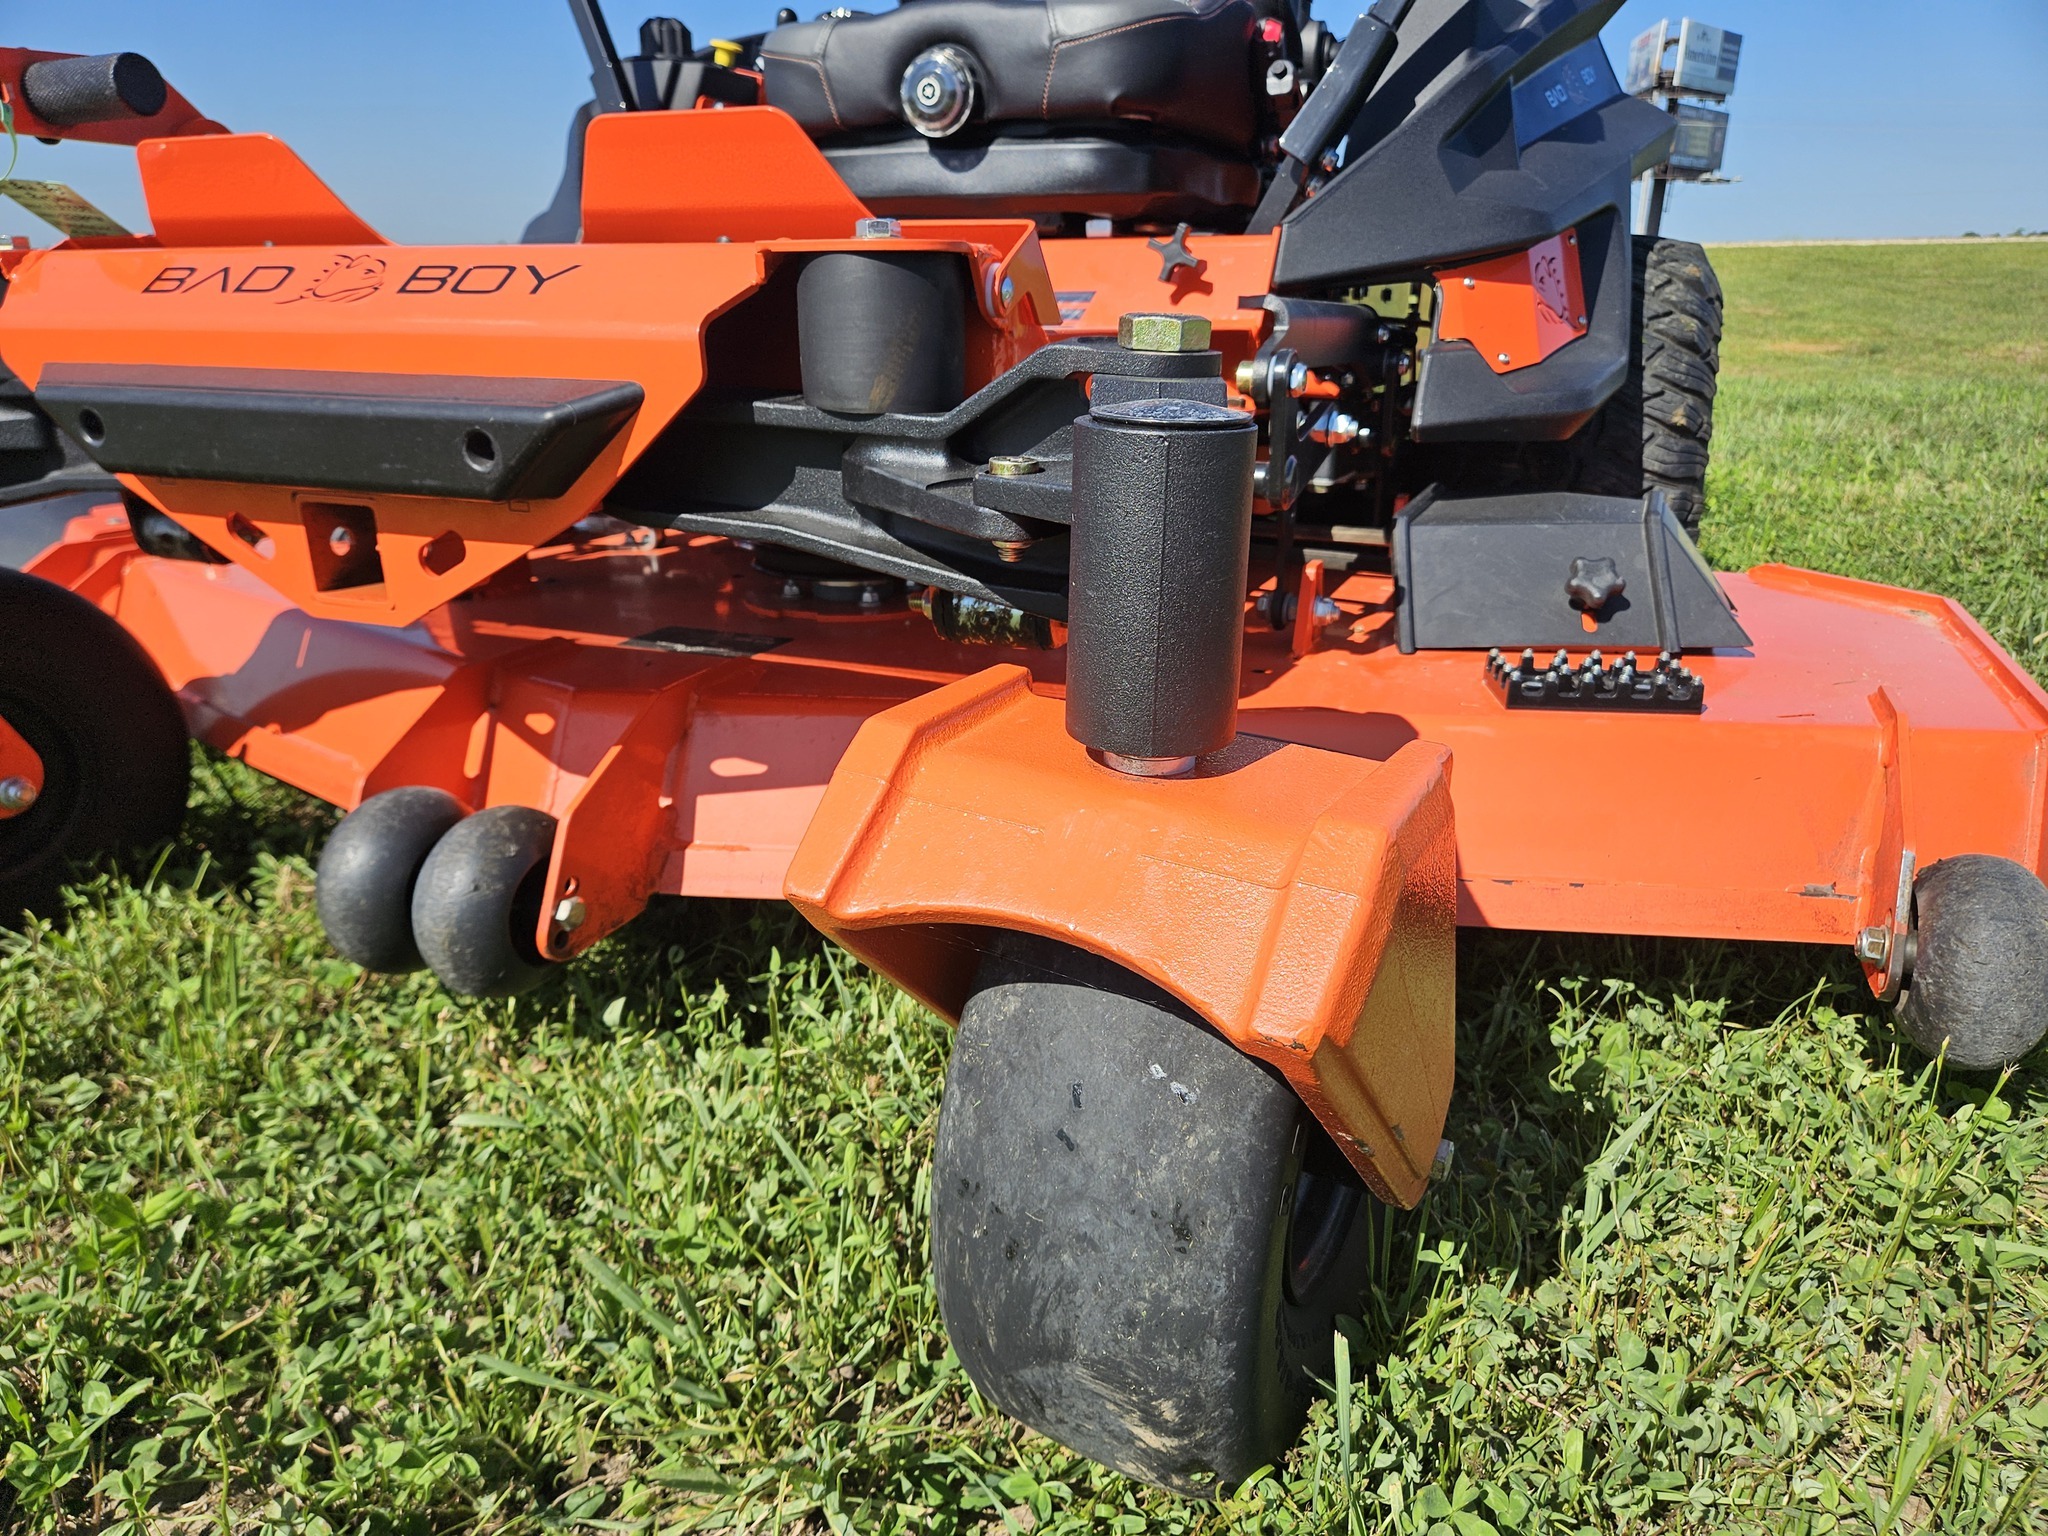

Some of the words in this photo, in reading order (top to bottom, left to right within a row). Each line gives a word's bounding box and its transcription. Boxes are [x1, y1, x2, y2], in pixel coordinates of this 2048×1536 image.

[1544, 84, 1568, 108] BAD
[141, 266, 295, 294] BAD
[396, 265, 582, 295] BOY
